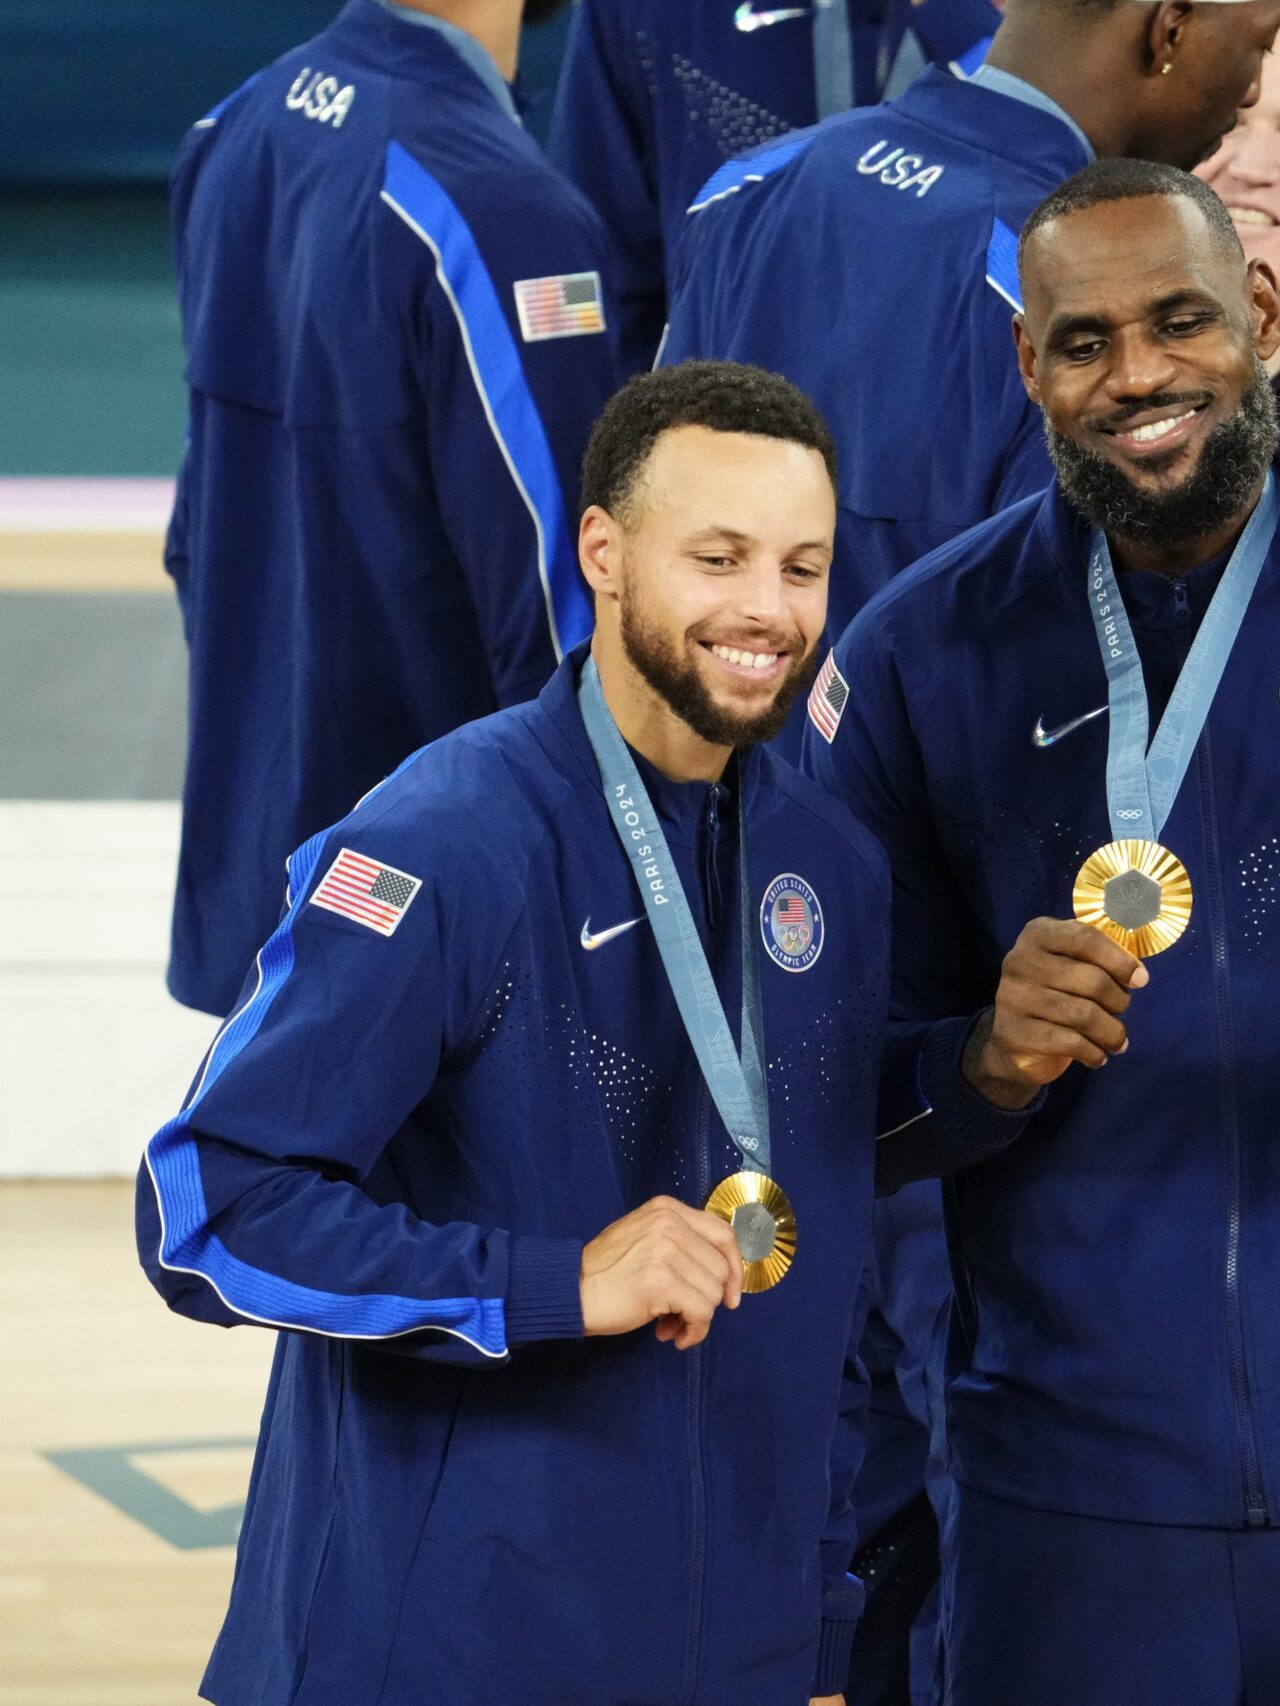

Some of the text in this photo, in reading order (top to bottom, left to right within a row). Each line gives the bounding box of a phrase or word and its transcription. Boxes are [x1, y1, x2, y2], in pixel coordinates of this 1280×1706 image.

[286, 67, 355, 128] USA
[857, 140, 944, 198] USA
[1100, 604, 1122, 658] PARIS
[616, 783, 669, 905] PARIS 2024
[767, 879, 813, 903] UNITED STATES
[771, 943, 817, 966] OLYMPIC TEAM
